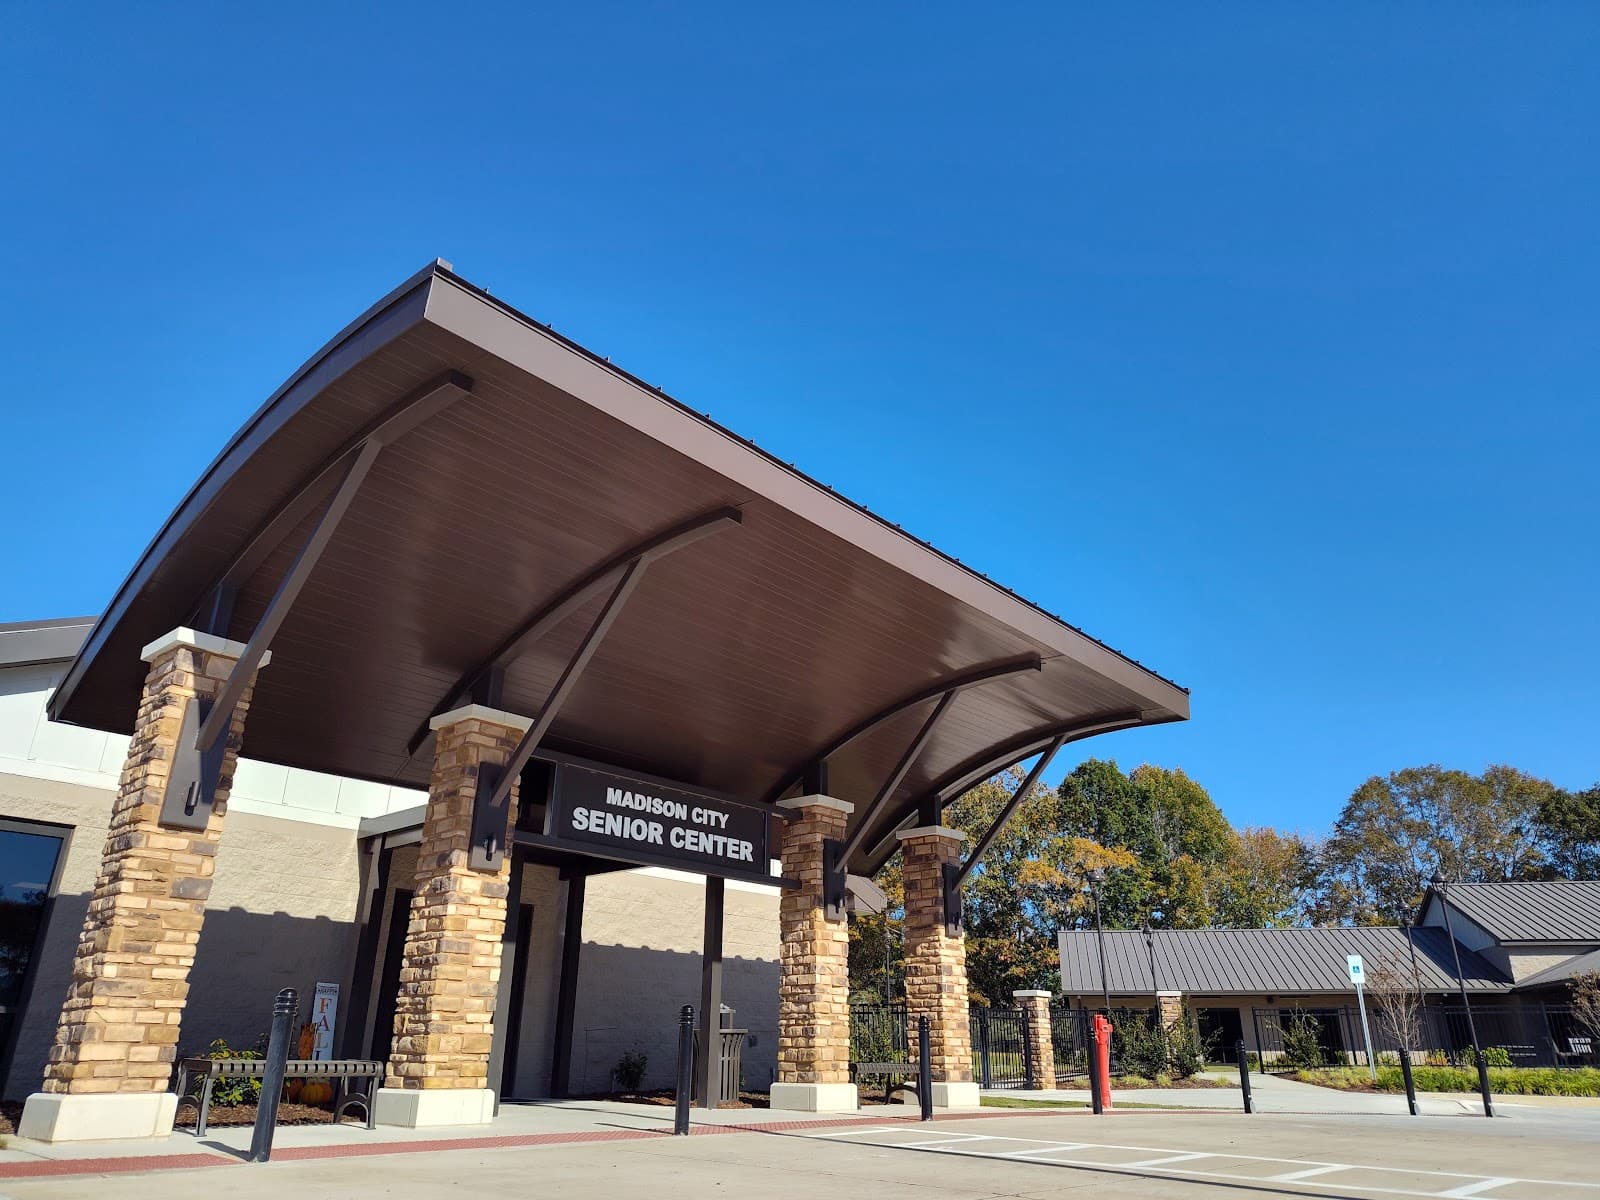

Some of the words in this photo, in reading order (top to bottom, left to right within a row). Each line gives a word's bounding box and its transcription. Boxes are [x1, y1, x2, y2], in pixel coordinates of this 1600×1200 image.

[606, 787, 687, 821] MADISON
[691, 807, 729, 829] CITY
[572, 807, 663, 845] SENIOR
[670, 827, 754, 862] CENTER
